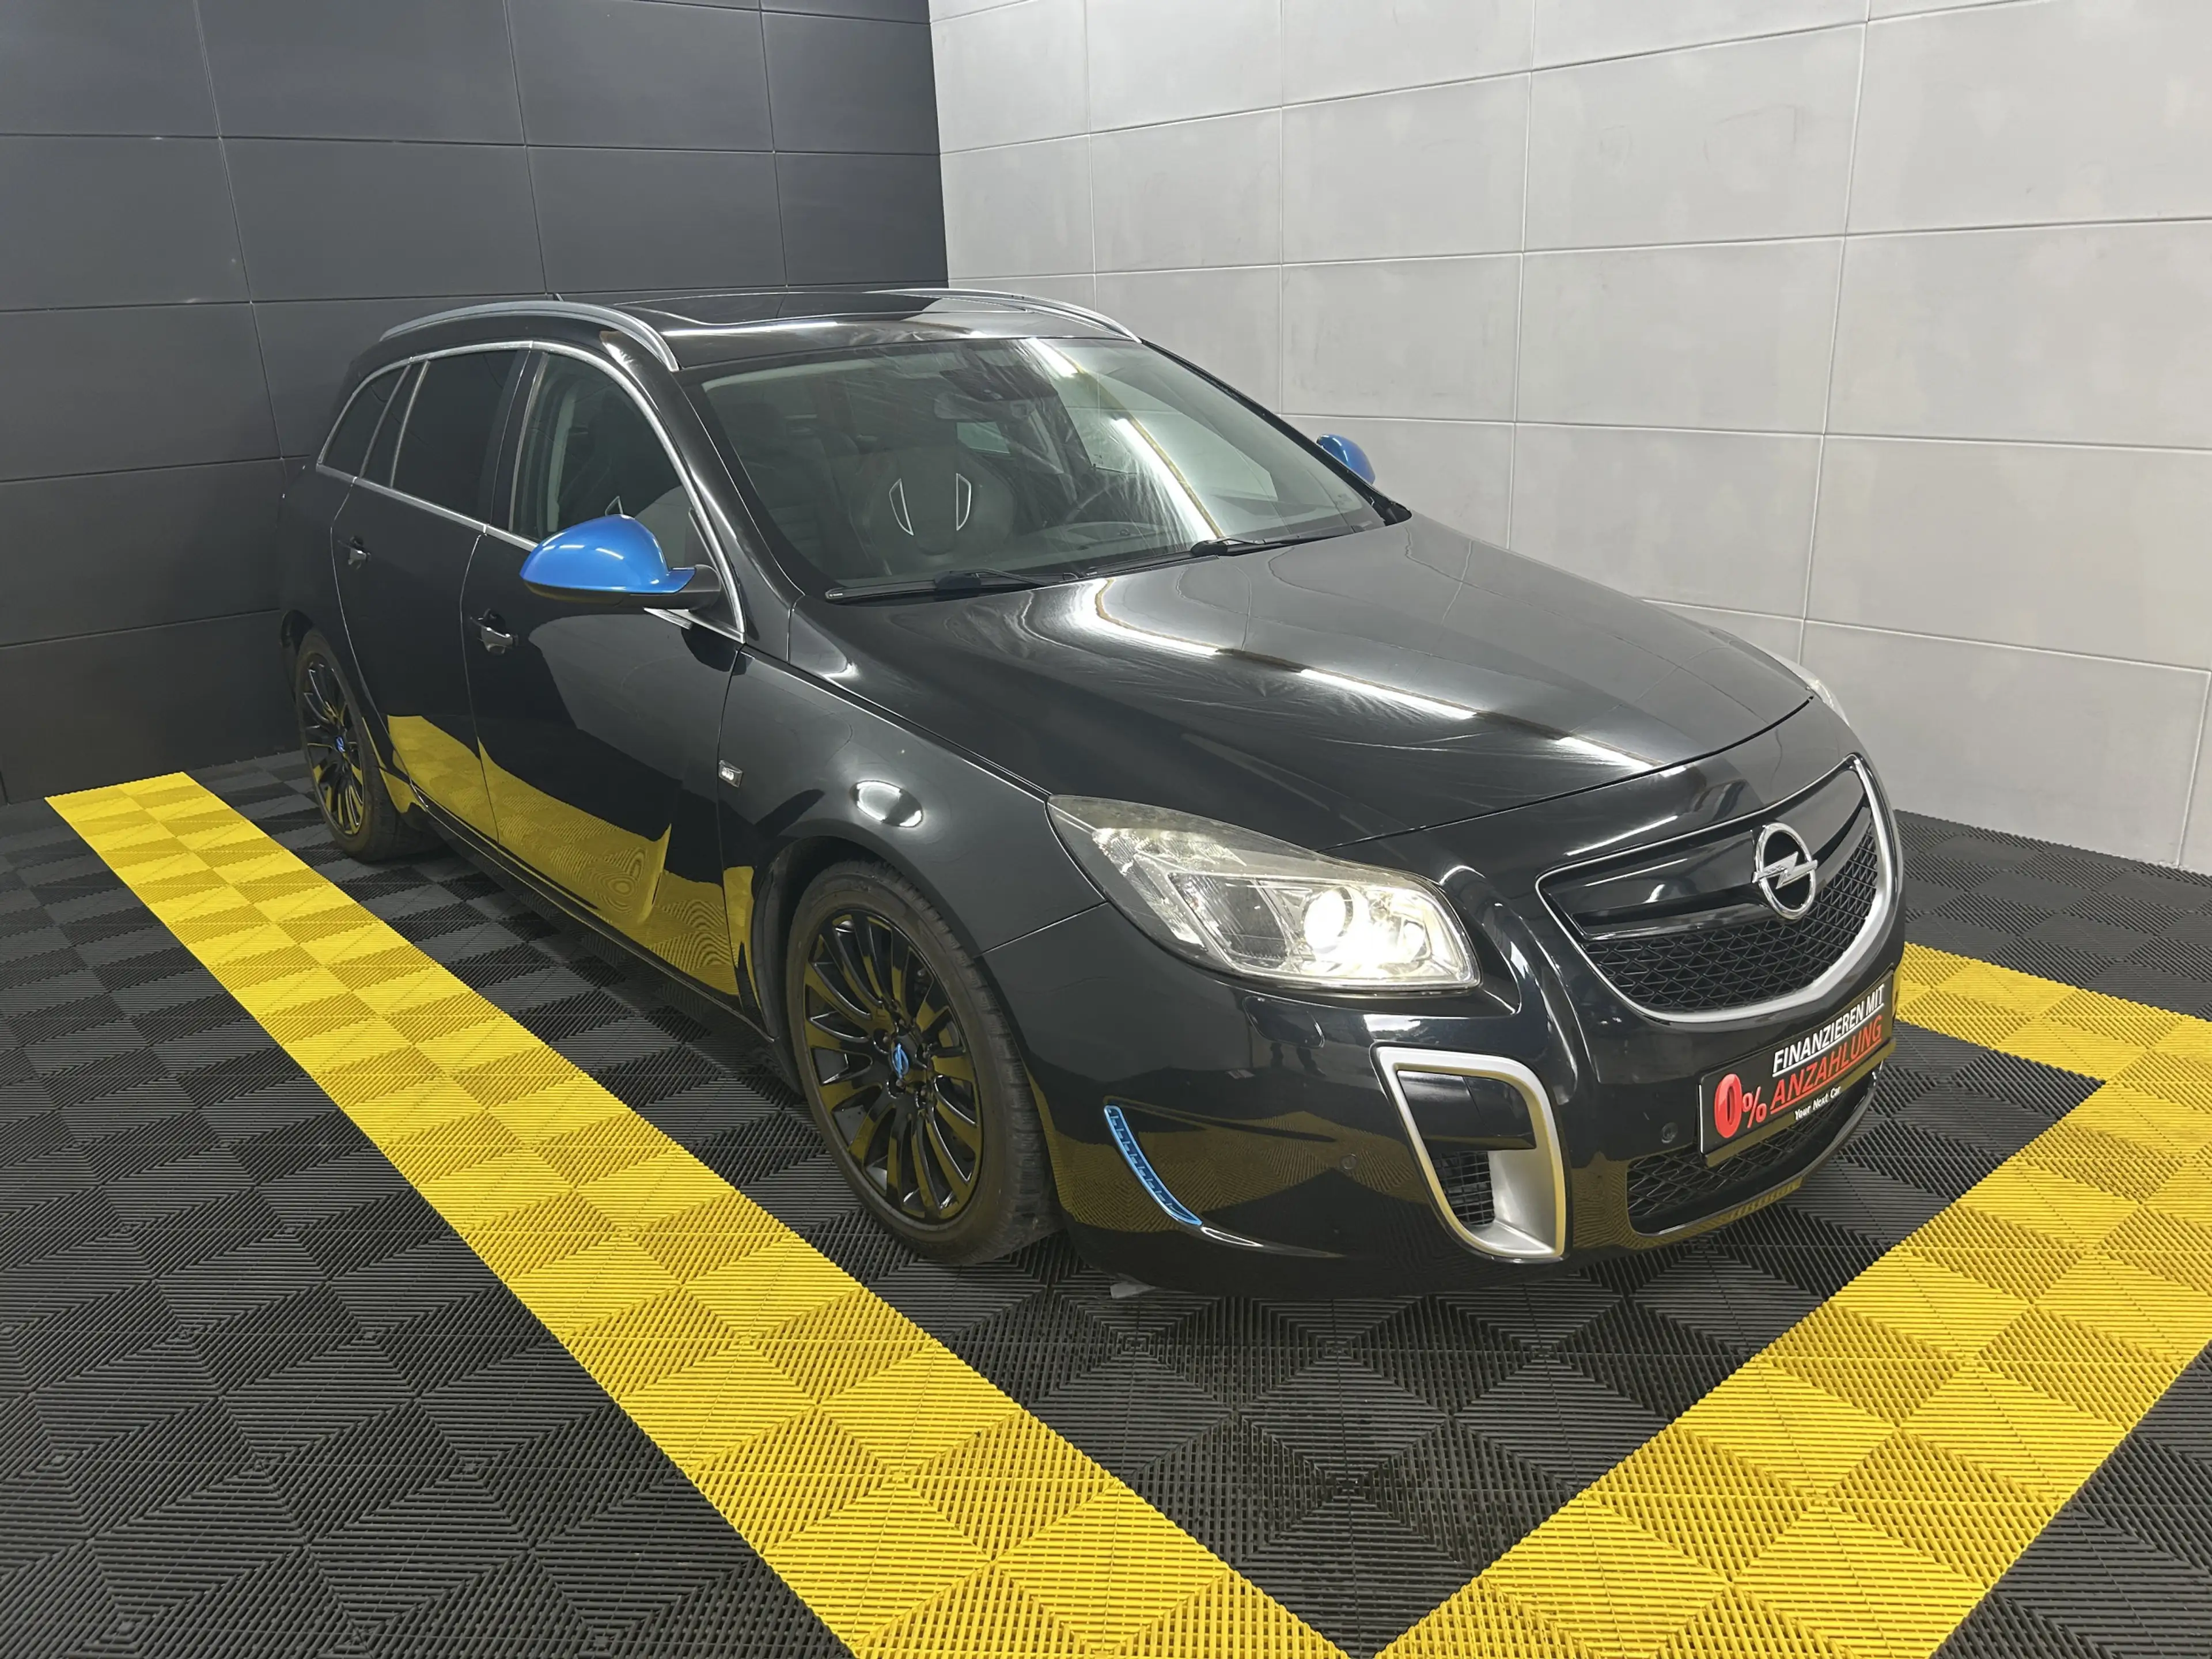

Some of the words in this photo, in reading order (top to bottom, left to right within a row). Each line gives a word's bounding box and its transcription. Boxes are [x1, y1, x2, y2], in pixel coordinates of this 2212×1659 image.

[1773, 1000, 1865, 1074] FINANZIEREN
[1865, 983, 1885, 1016] MIT
[1714, 1073, 1767, 1138] 0%
[1770, 1014, 1883, 1110] ANZAHLUNG
[1794, 1105, 1812, 1120] Your
[1813, 1093, 1828, 1111] Next
[1830, 1086, 1842, 1099] Car
